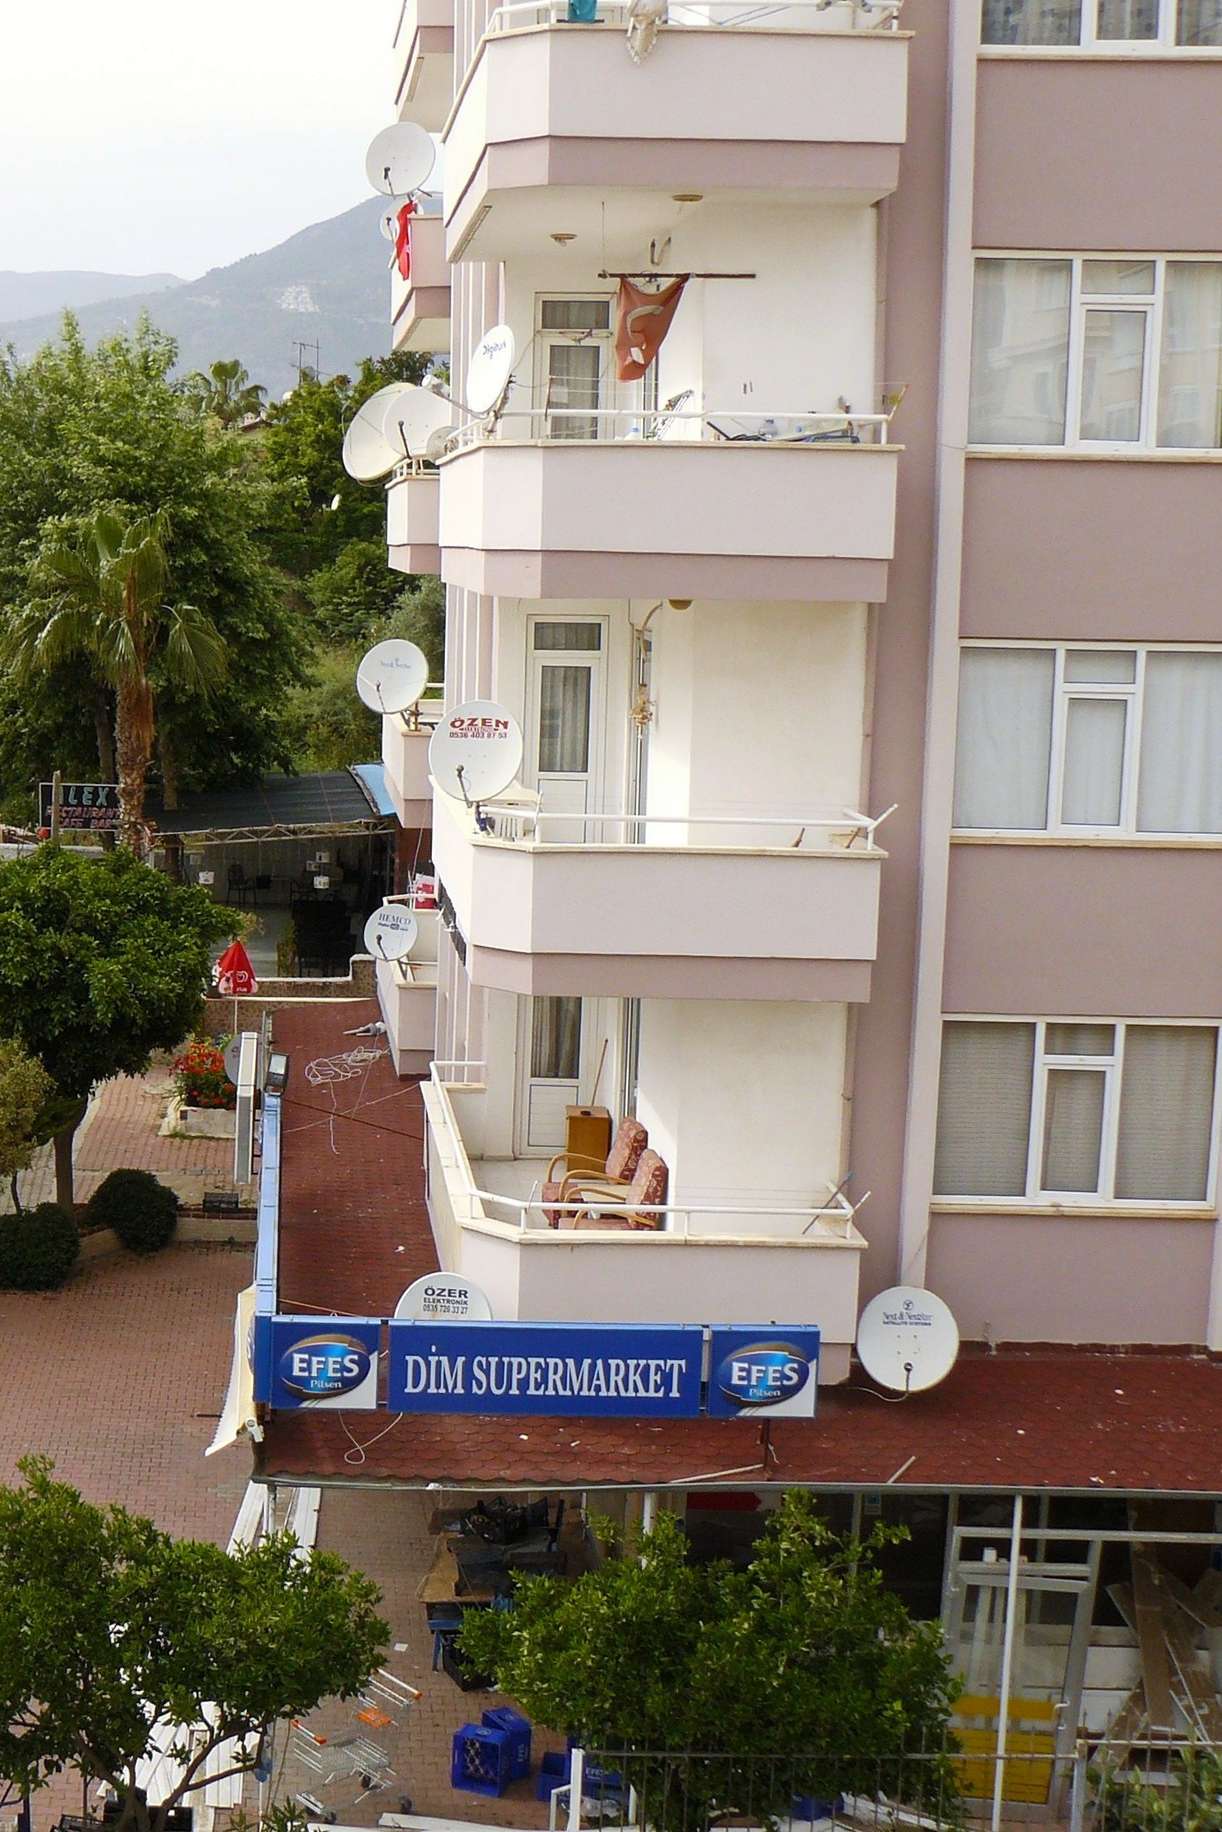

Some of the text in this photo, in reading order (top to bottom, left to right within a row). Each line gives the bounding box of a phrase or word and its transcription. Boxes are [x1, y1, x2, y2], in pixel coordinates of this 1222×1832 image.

[449, 717, 509, 730] ÖZEN
[449, 731, 469, 739] 0536
[424, 1285, 469, 1299] ÖZER
[460, 1306, 469, 1315] 27
[292, 1353, 360, 1378] EFES
[404, 1345, 687, 1398] DİM SUPERMARKET
[730, 1362, 799, 1386] EFES
[310, 1379, 342, 1389] Pilsen
[749, 1388, 781, 1398] Pilsen
